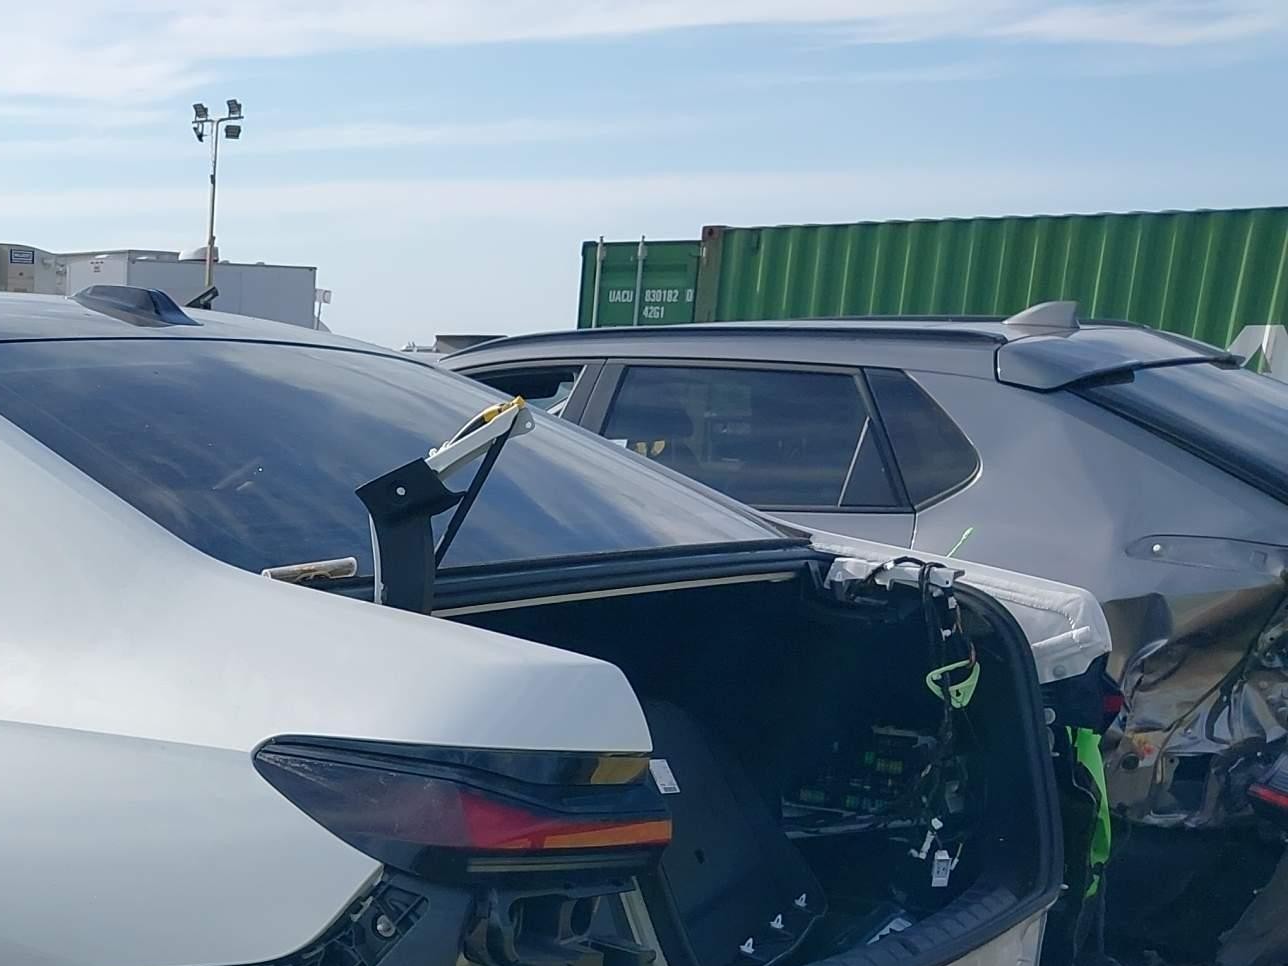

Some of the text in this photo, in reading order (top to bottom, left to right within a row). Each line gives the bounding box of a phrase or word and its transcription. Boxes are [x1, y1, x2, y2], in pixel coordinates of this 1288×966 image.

[608, 289, 633, 303] UACU
[644, 289, 679, 303] 830182
[642, 306, 665, 319] 42G1
